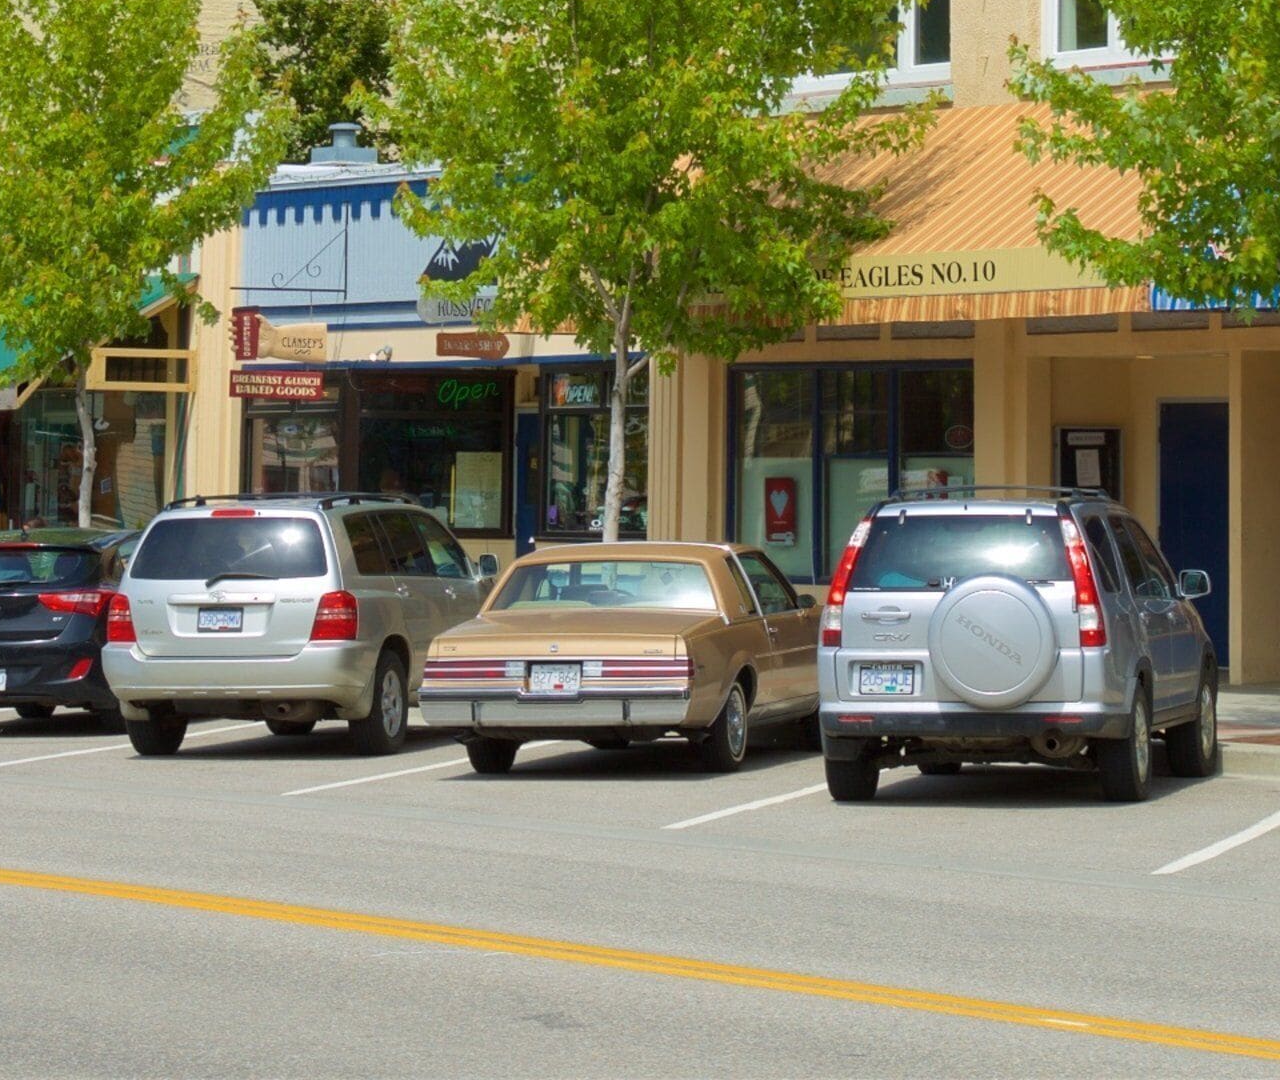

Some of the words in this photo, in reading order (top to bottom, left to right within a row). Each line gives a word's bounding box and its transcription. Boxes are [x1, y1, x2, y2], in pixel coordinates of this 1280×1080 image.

[841, 263, 924, 290] EAGLES
[282, 336, 324, 349] CLANSEY'S
[235, 385, 275, 395] BAKED
[276, 386, 317, 397] GOODS
[437, 378, 500, 410] Open
[957, 615, 1022, 667] HONDA
